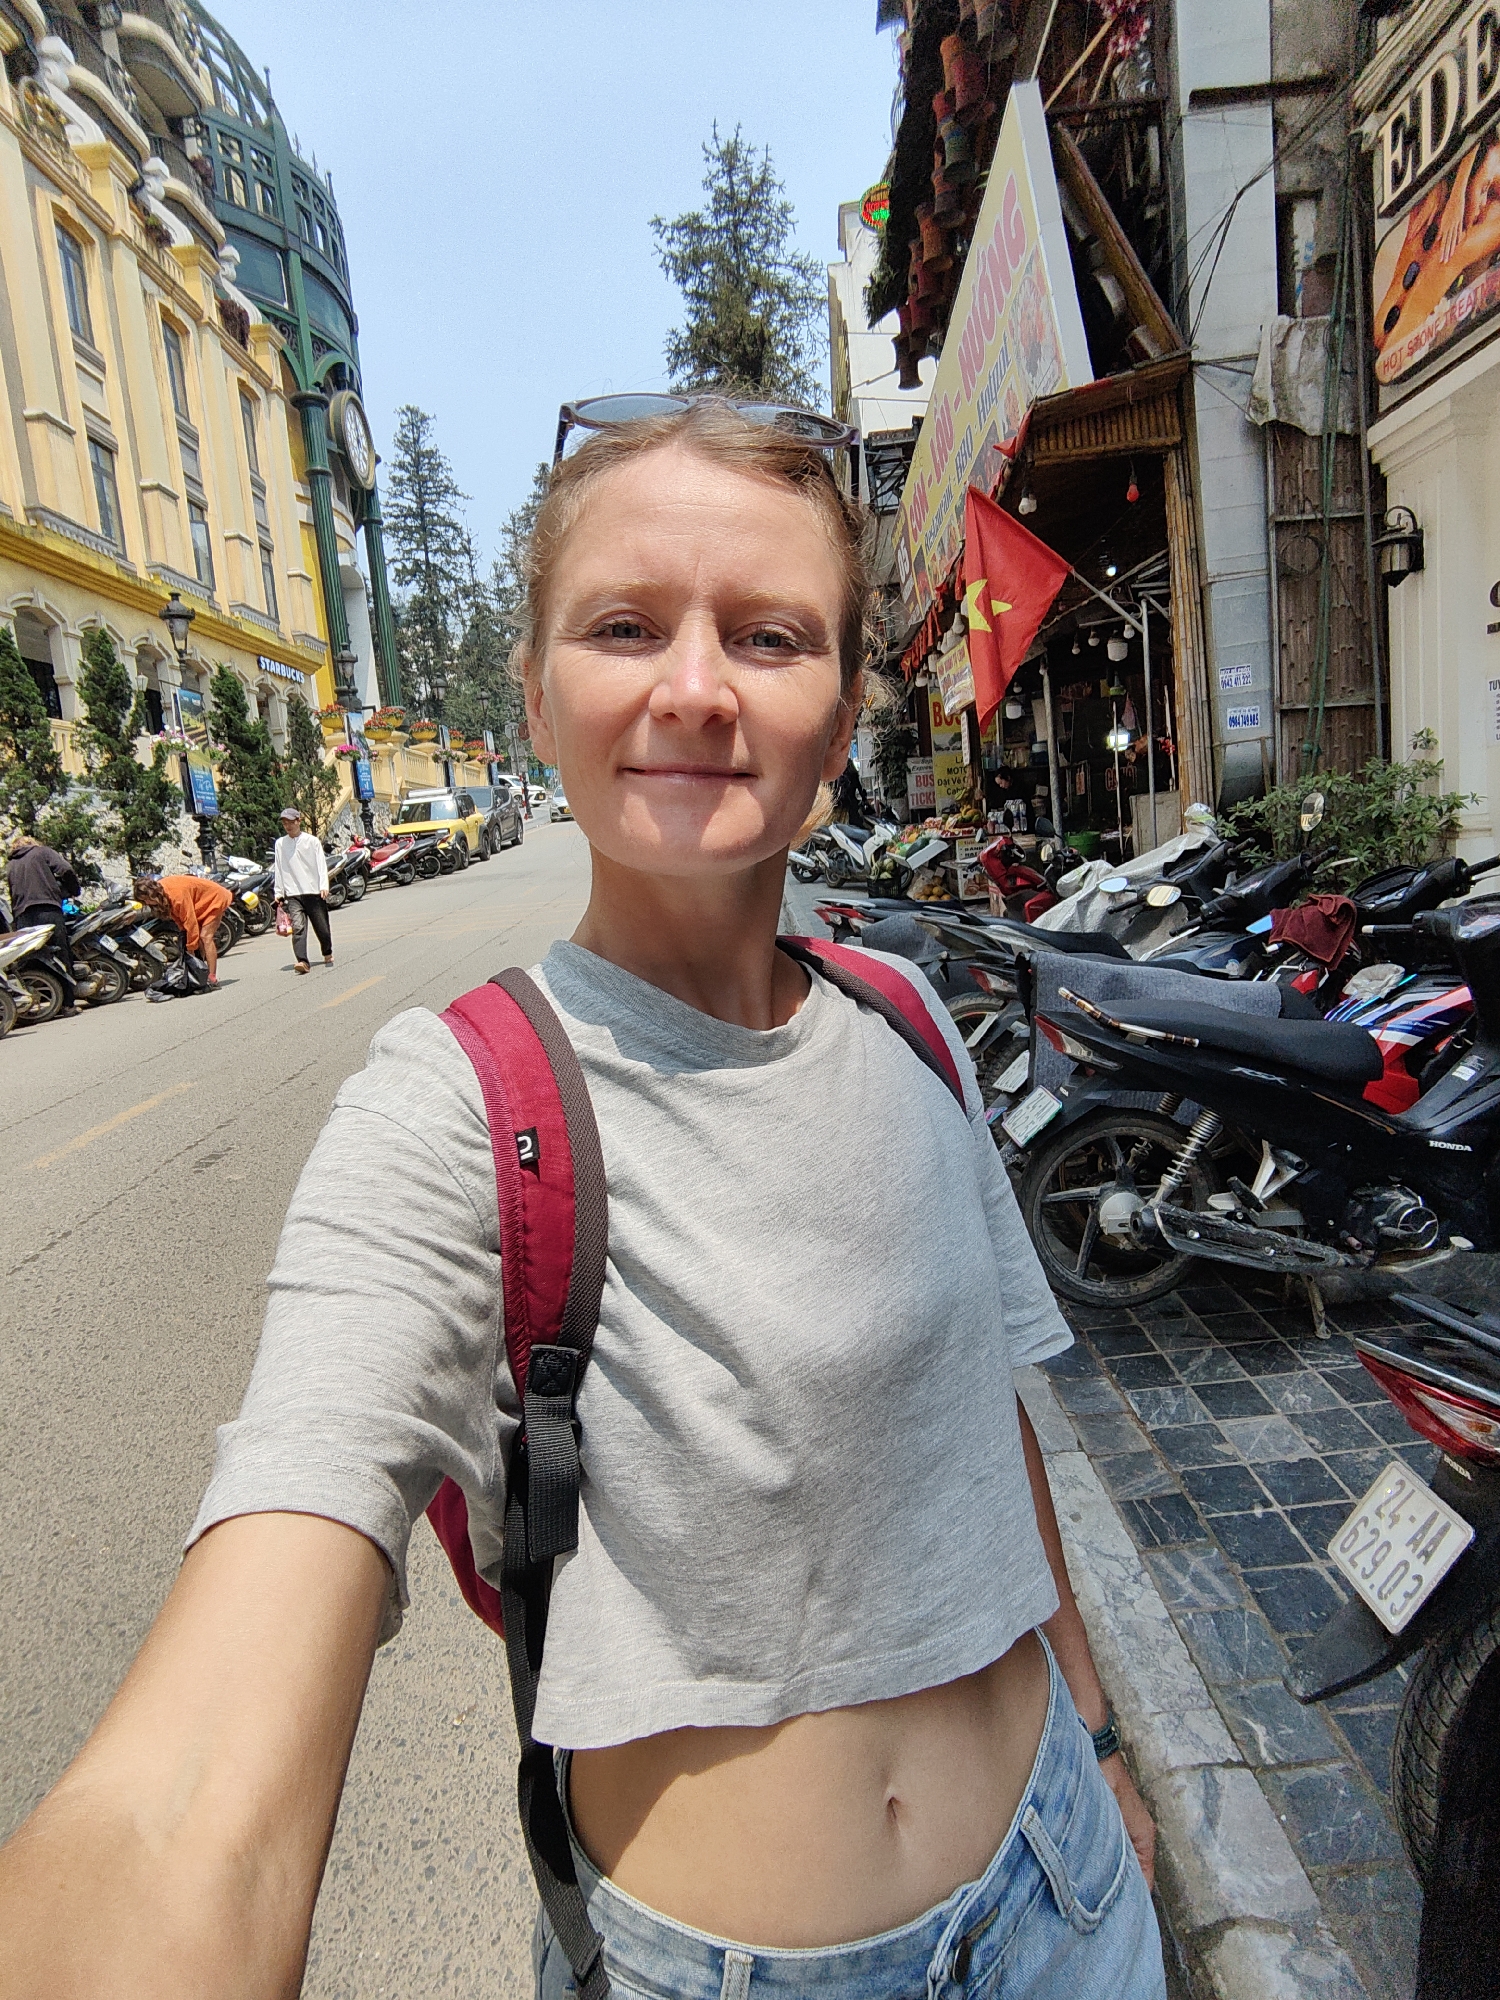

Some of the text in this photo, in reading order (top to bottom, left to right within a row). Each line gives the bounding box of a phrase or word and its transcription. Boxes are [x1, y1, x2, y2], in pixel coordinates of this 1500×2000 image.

[958, 169, 1027, 404] NƯỚNG
[1383, 347, 1404, 375] HOT
[1407, 317, 1441, 357] STONE
[955, 423, 973, 485] BBQ
[977, 331, 1011, 432] Hotpot
[259, 655, 305, 684] STARBUCKS
[915, 773, 935, 788] BUS
[1429, 1140, 1473, 1151] HONDA
[1443, 1454, 1473, 1482] HONDA
[1339, 1515, 1424, 1616] 629.03
